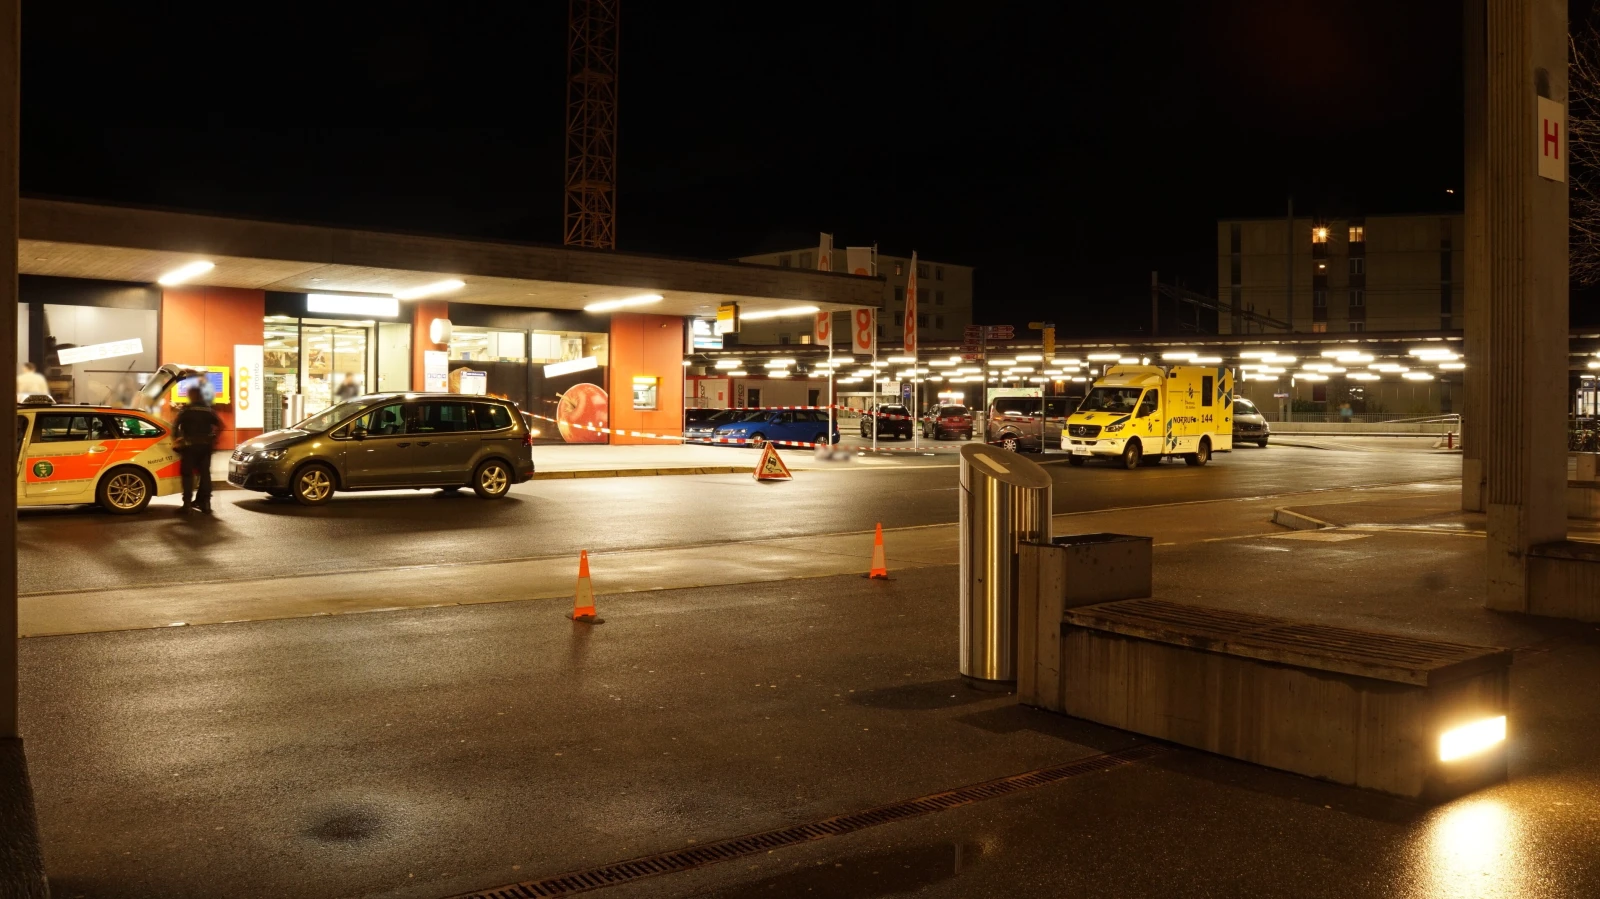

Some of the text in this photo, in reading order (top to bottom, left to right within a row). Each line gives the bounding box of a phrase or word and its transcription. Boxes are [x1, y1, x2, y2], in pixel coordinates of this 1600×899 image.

[1544, 119, 1558, 159] H
[238, 366, 252, 411] coop
[253, 362, 261, 391] pronto
[1172, 413, 1213, 424] NOTRUF 144
